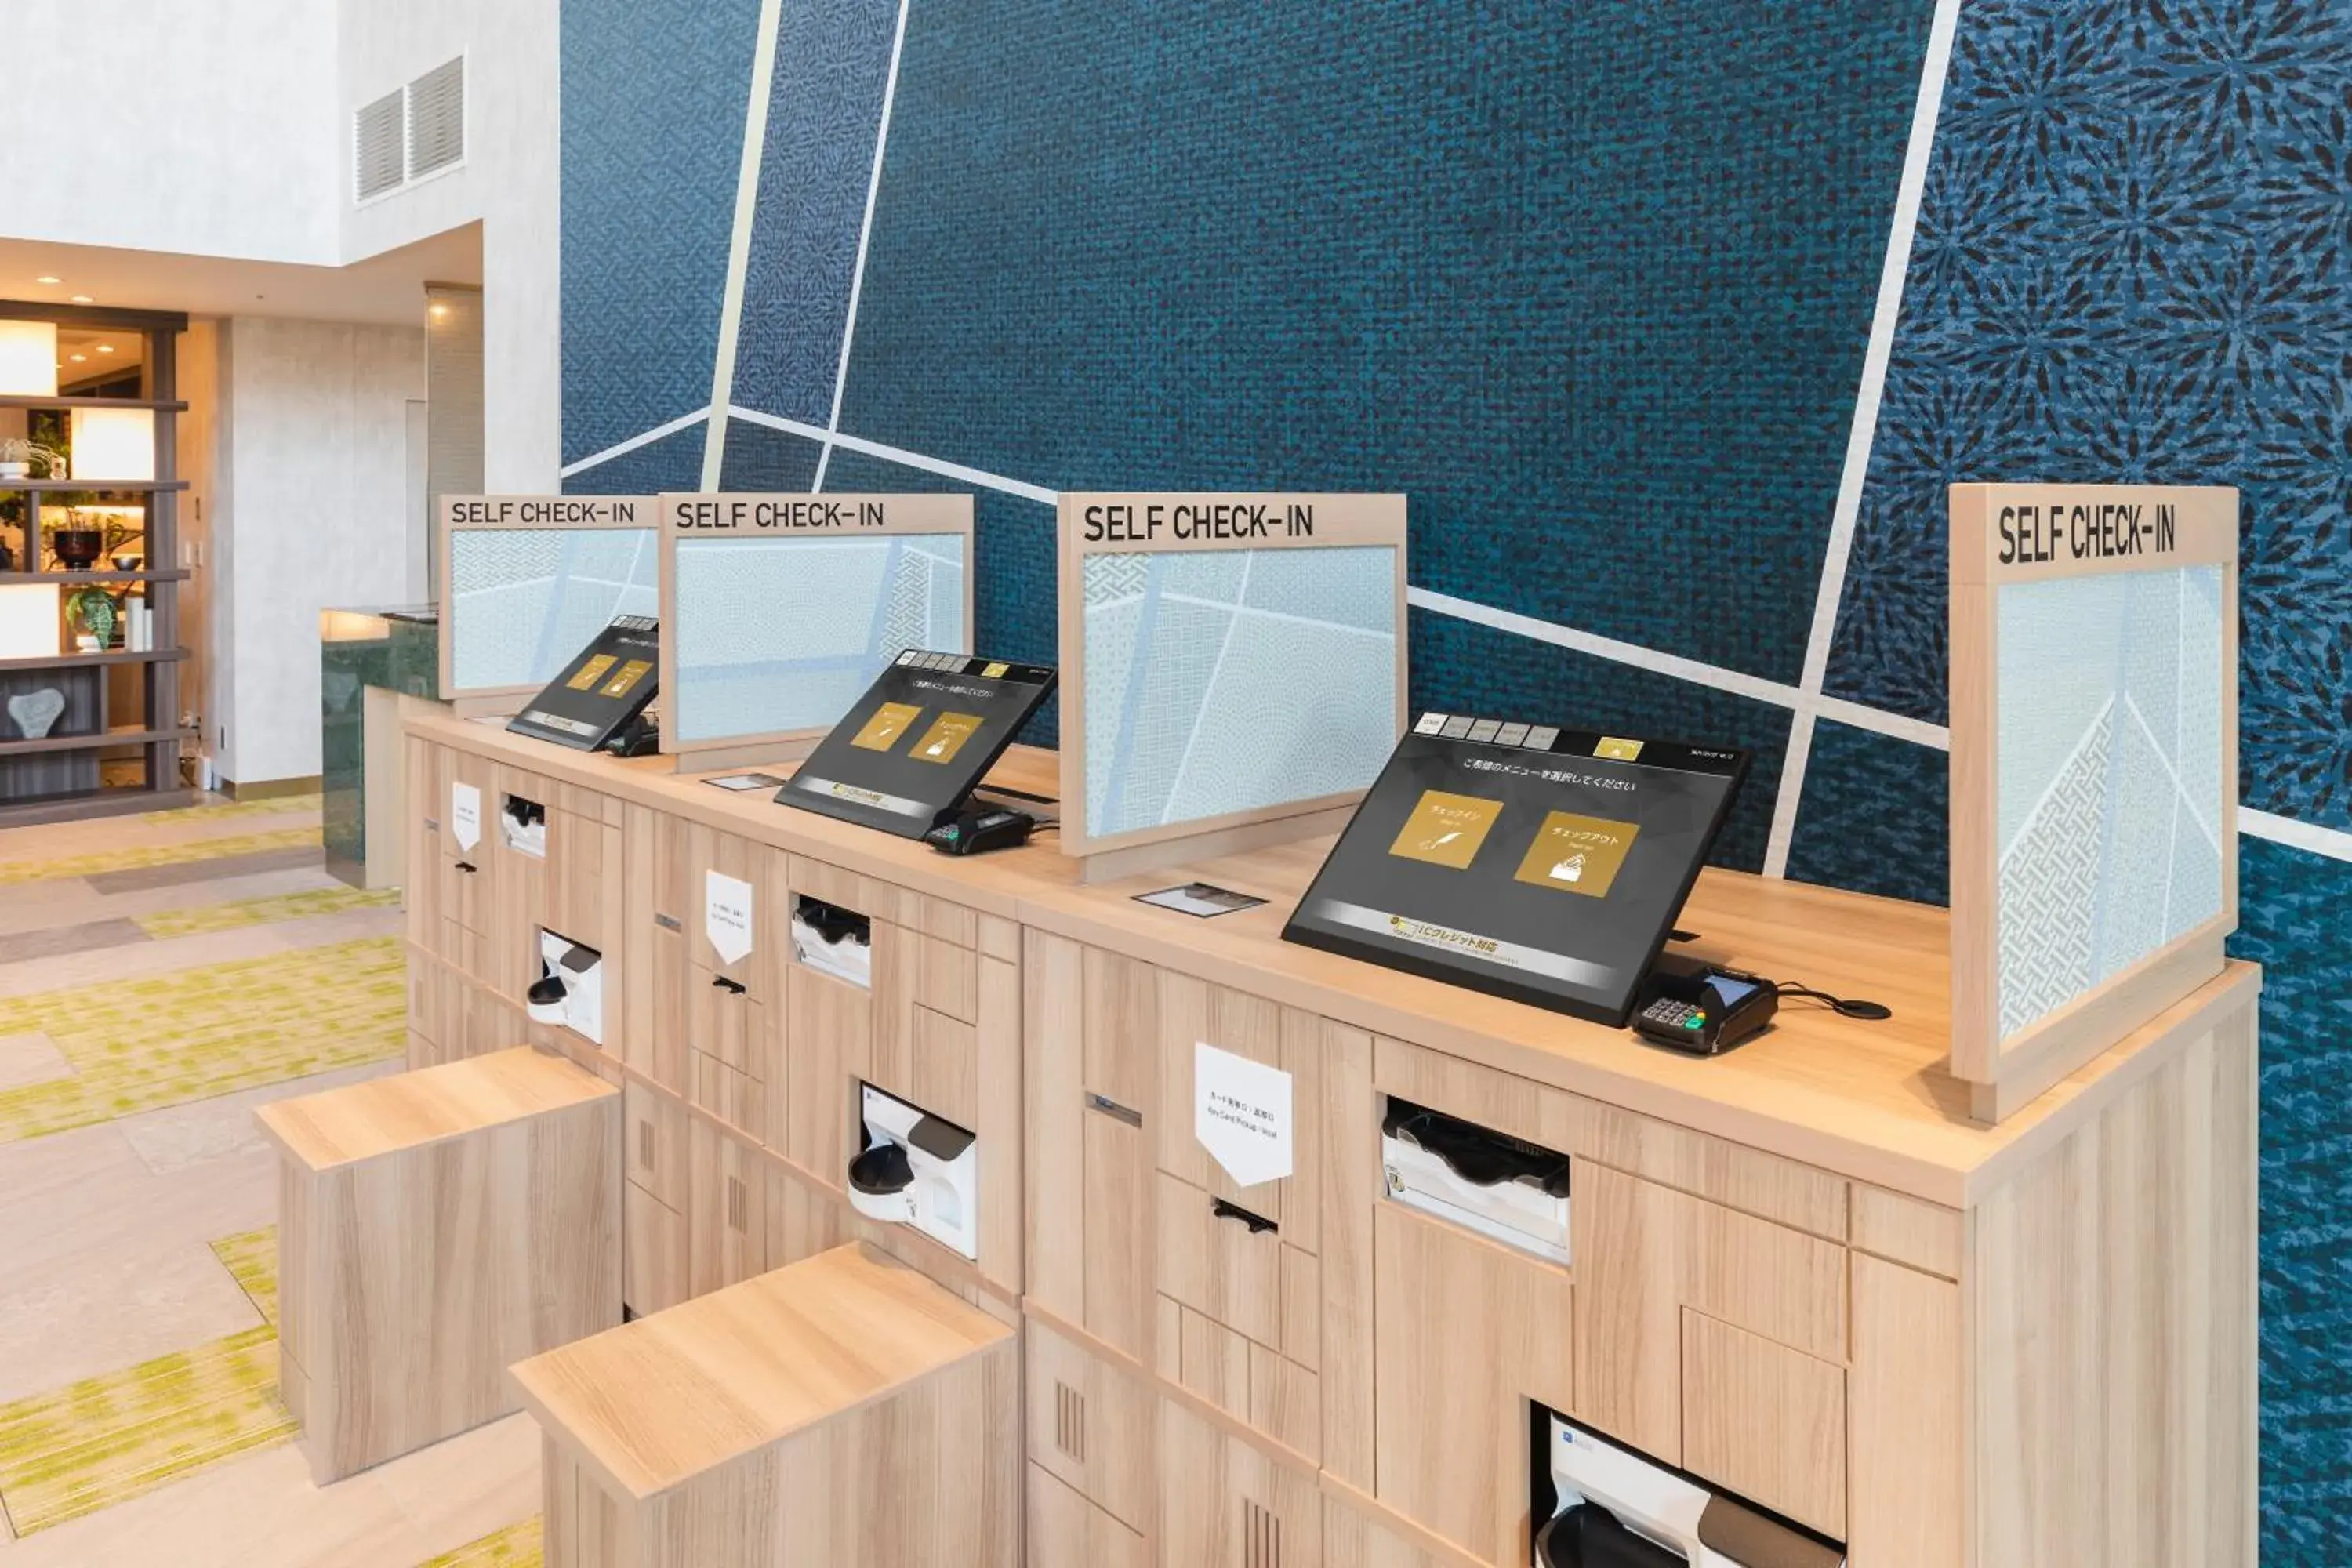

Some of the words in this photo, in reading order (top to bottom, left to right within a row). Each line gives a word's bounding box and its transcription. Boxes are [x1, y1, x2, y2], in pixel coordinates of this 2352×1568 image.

[452, 503, 513, 523] SELF
[521, 503, 633, 523] CHECK-IN
[677, 503, 746, 528] SELF
[756, 503, 884, 528] CHECK-IN
[1085, 506, 1164, 542] SELF
[1174, 504, 1313, 540] CHECK-IN
[1998, 506, 2064, 564] SELF
[2071, 504, 2175, 559] CHECK-IN
